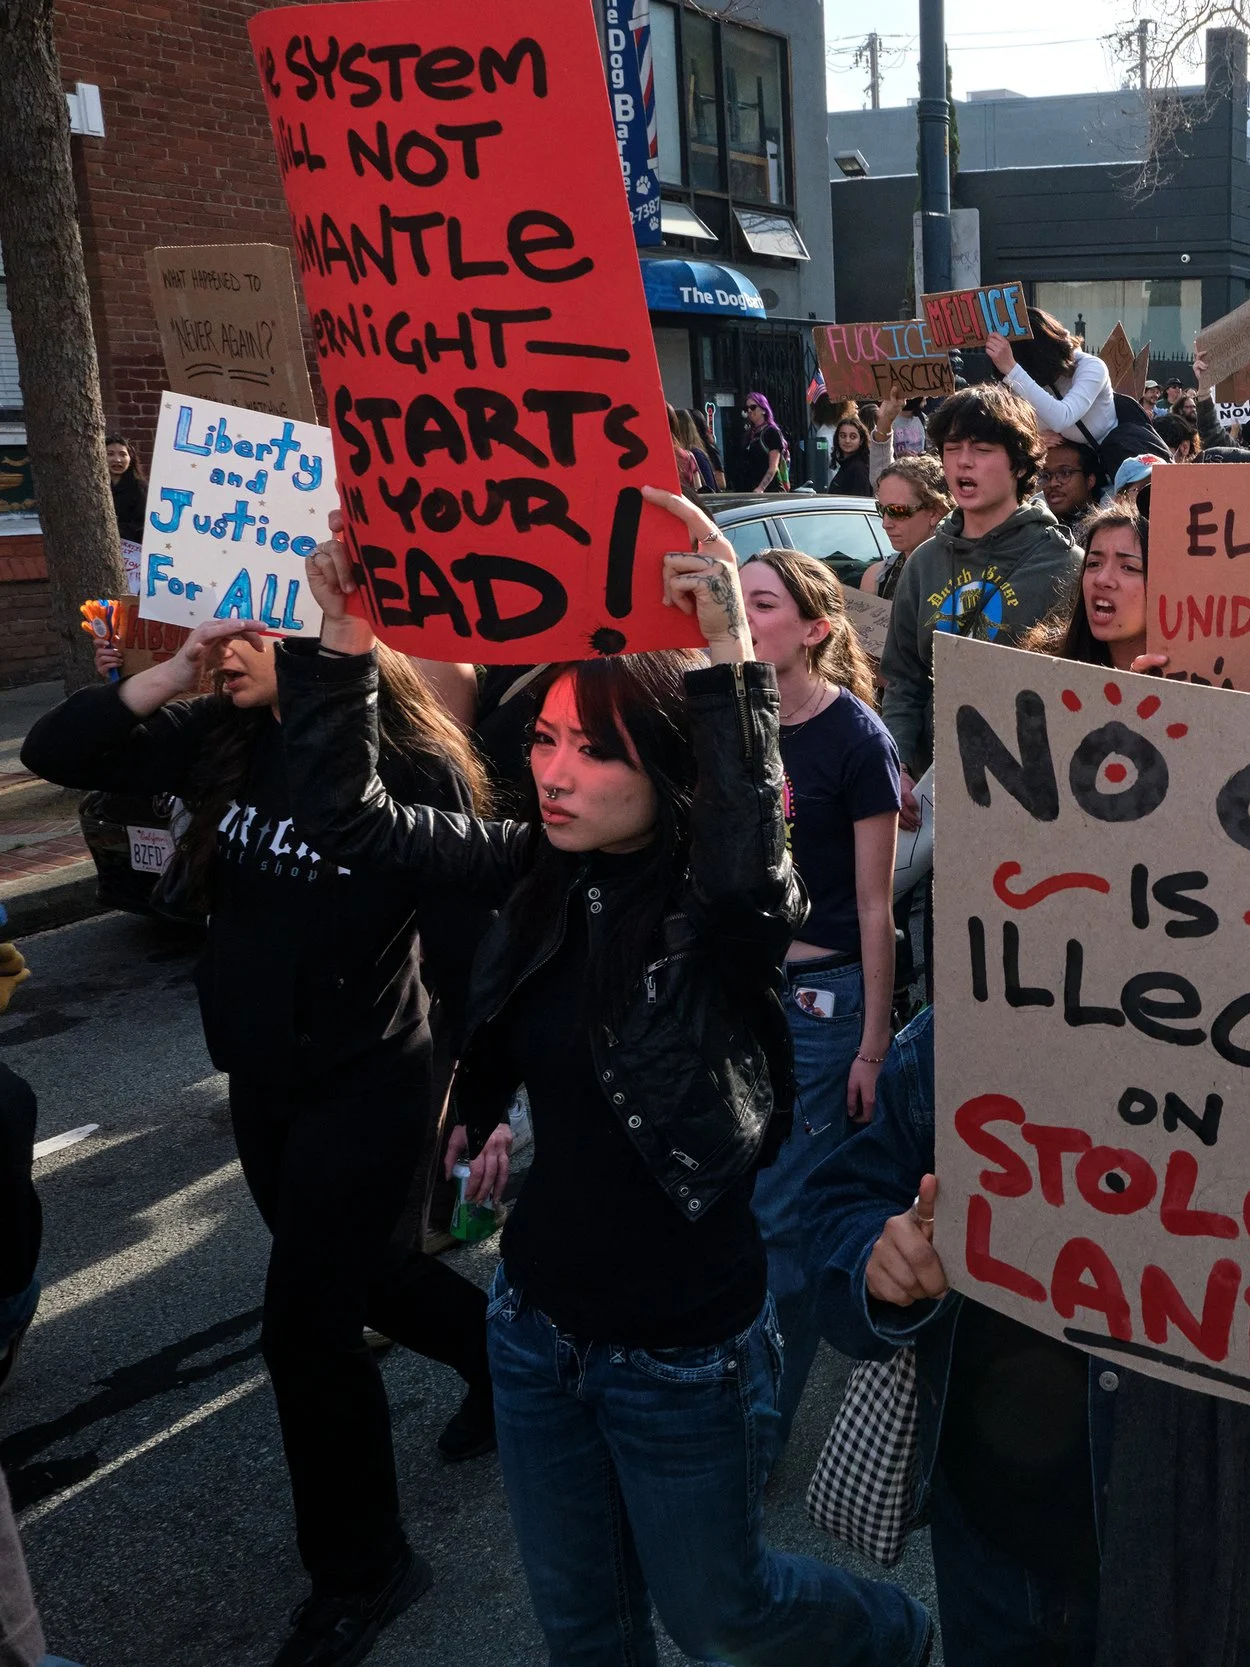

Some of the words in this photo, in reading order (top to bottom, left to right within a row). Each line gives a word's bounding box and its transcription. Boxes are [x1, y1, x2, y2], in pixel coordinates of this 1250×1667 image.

[608, 29, 625, 89] Dog
[347, 121, 503, 187] NOT
[162, 268, 188, 288] WHAT
[192, 269, 241, 292] HAPPENED
[244, 273, 262, 292] TO
[680, 287, 714, 305] The
[715, 289, 748, 311] Dog
[826, 325, 888, 363] FUCK
[926, 291, 984, 348] MELT
[978, 286, 1028, 337] ICE
[871, 362, 954, 398] FASCISM
[173, 405, 322, 491] Liberty
[209, 467, 269, 495] and
[150, 486, 320, 558] Justice
[342, 483, 369, 527] IN
[378, 476, 592, 547] YOUR
[147, 552, 204, 601] For
[956, 689, 1170, 823] NO
[1131, 863, 1220, 939] IS
[1118, 1086, 1224, 1146] ON
